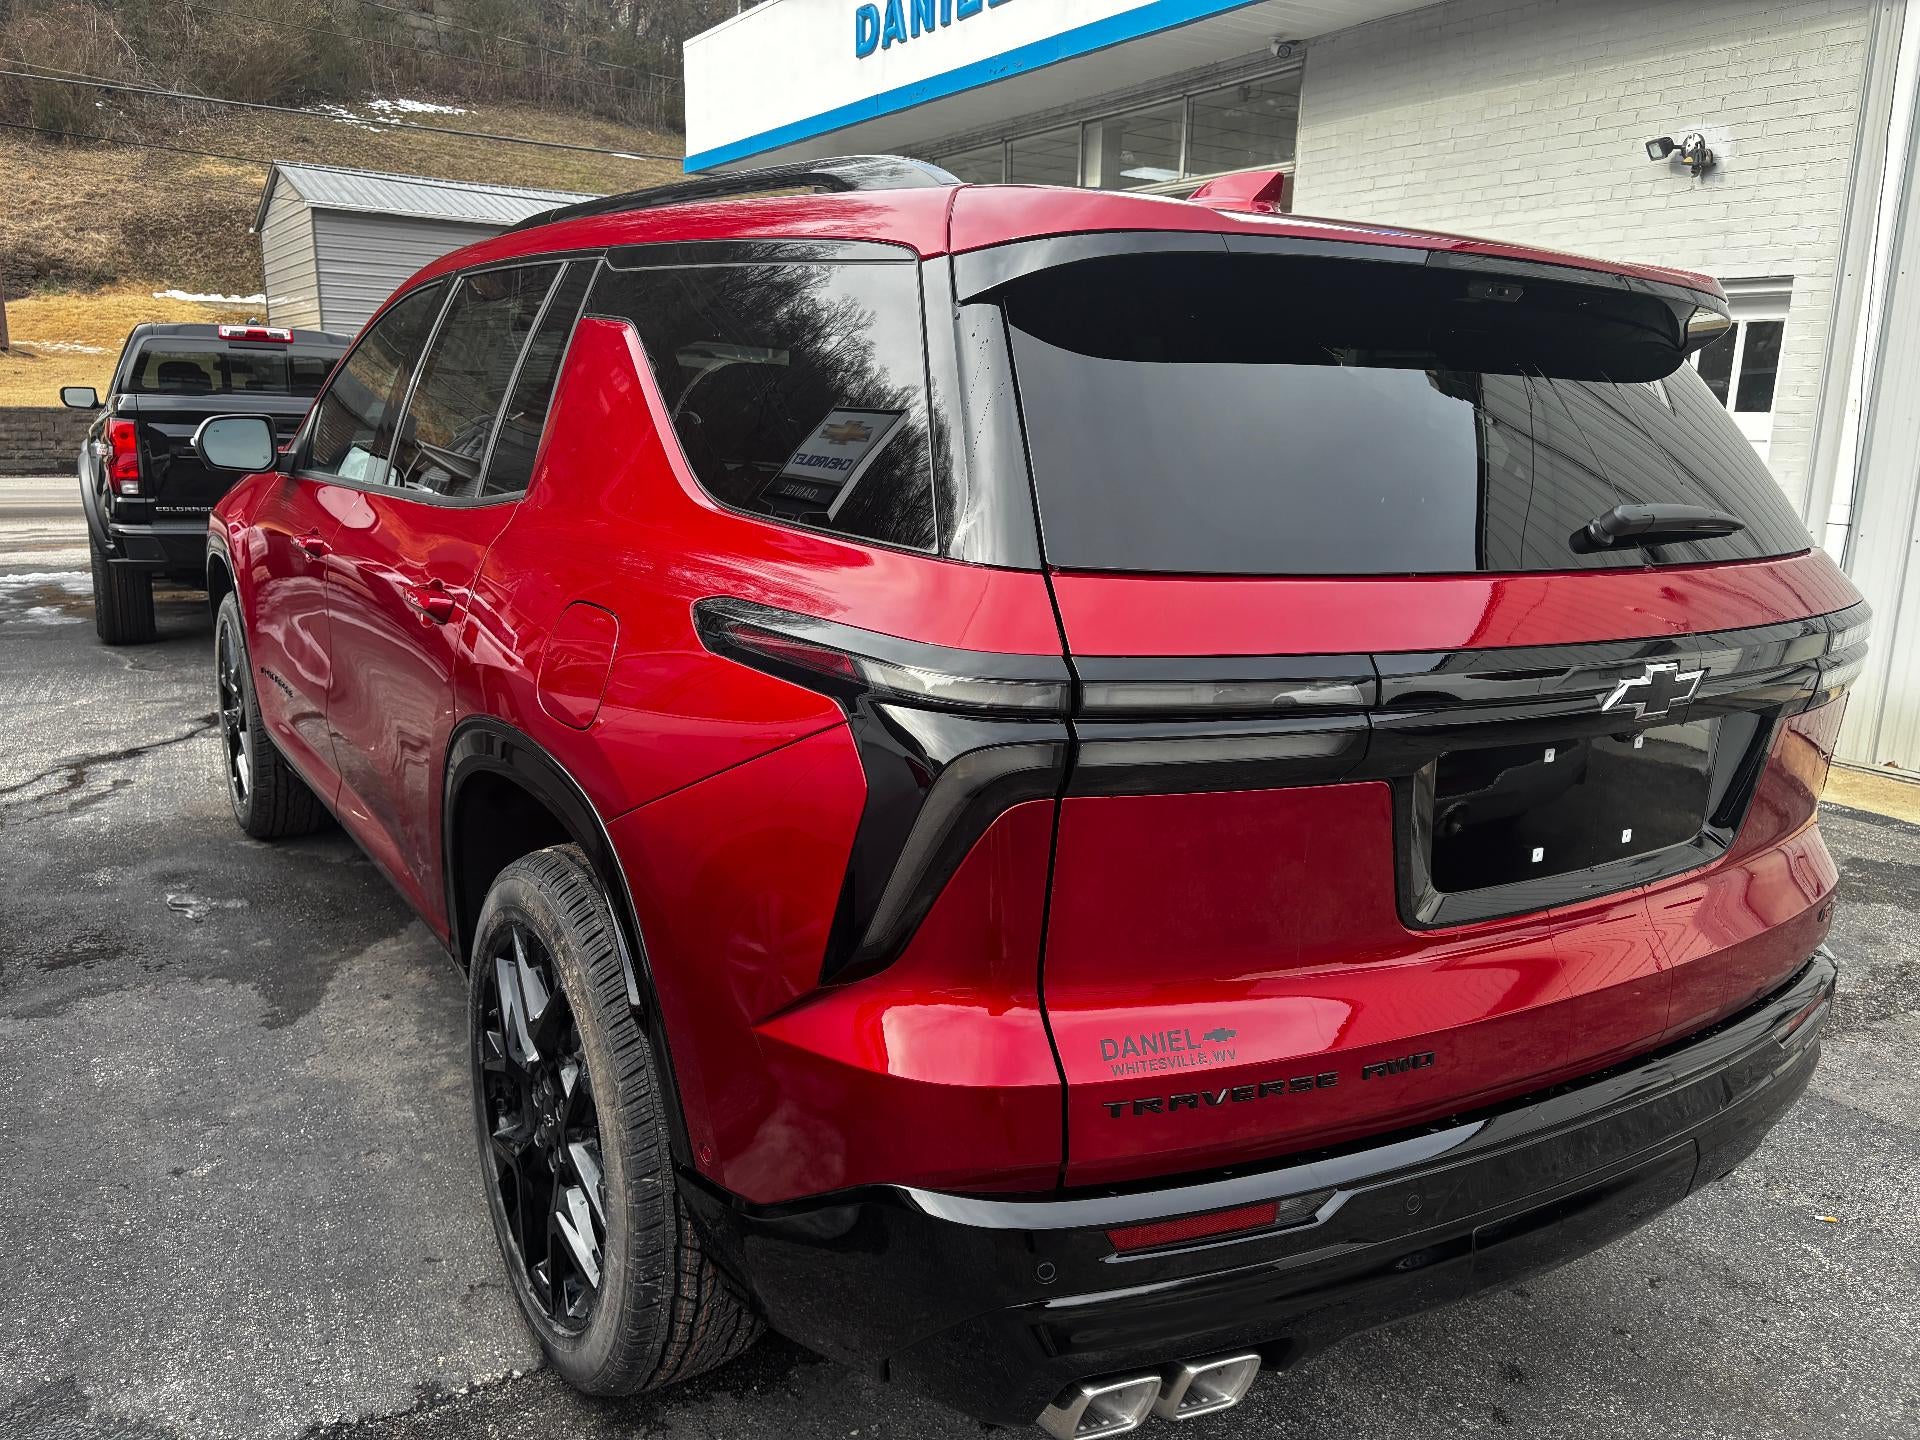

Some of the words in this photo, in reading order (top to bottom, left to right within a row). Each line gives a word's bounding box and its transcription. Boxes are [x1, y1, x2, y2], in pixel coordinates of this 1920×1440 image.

[855, 0, 1014, 59] DANI
[1100, 1028, 1202, 1061] DANIEL
[1103, 1071, 1339, 1118] TRAVERSE
[1362, 1051, 1436, 1081] AWD
